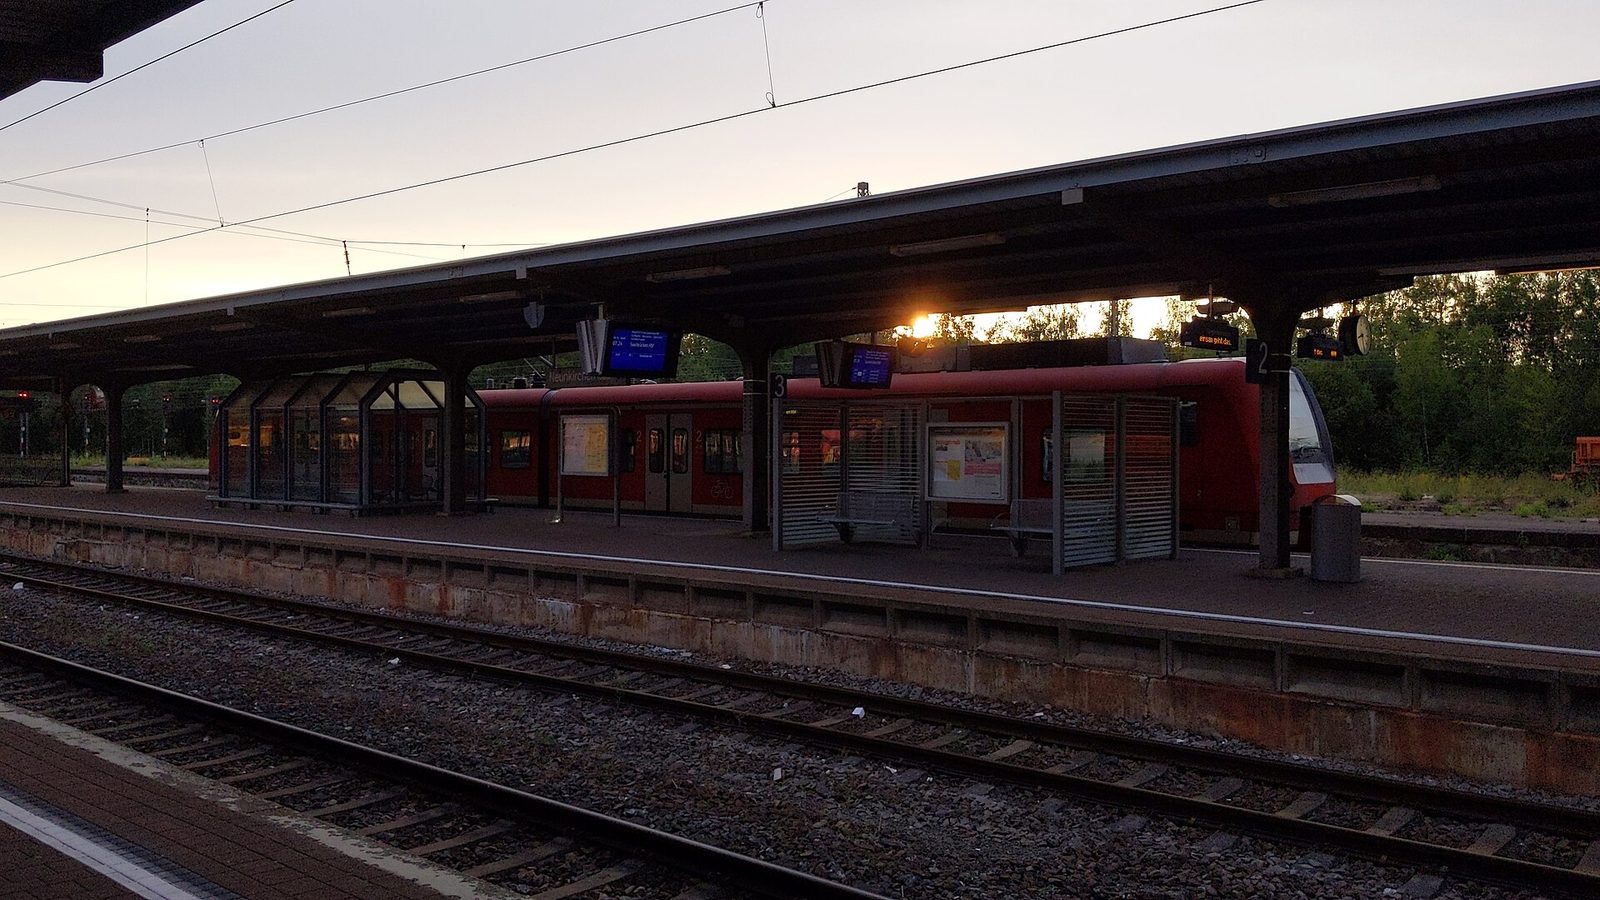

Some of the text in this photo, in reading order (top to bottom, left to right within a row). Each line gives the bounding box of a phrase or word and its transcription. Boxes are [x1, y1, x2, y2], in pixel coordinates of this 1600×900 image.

[1258, 342, 1268, 374] 2
[774, 374, 785, 397] 3
[636, 430, 642, 442] 2
[696, 430, 703, 442] 2
